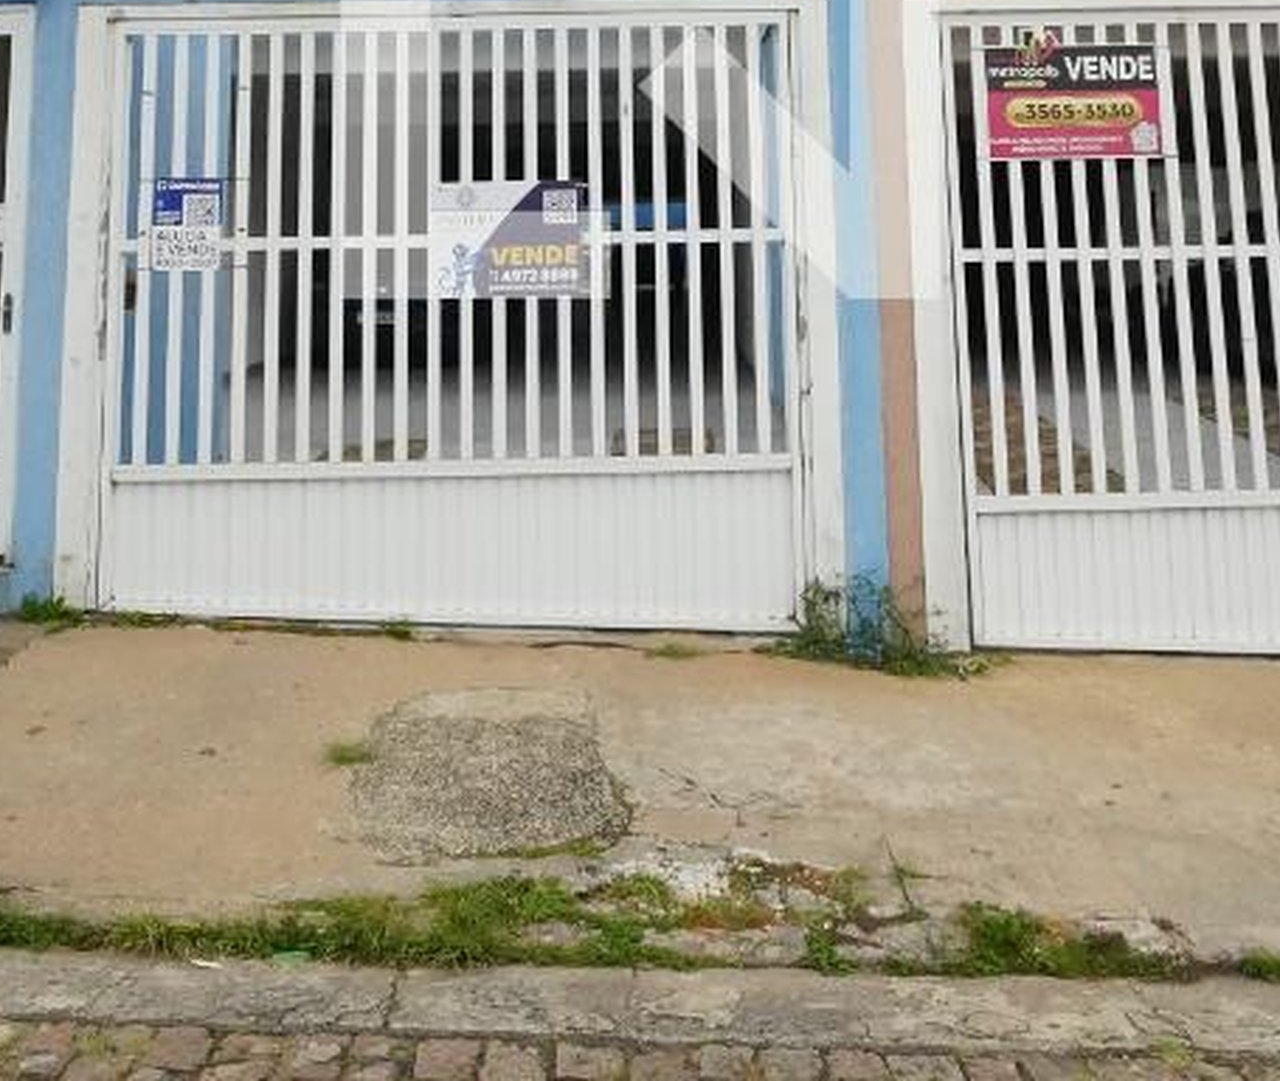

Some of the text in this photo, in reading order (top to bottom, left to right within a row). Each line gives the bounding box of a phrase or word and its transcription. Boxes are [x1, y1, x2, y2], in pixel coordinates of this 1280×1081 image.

[1064, 55, 1156, 81] VENDE
[1025, 102, 1135, 120] 3565-3530
[490, 243, 578, 266] VENDE
